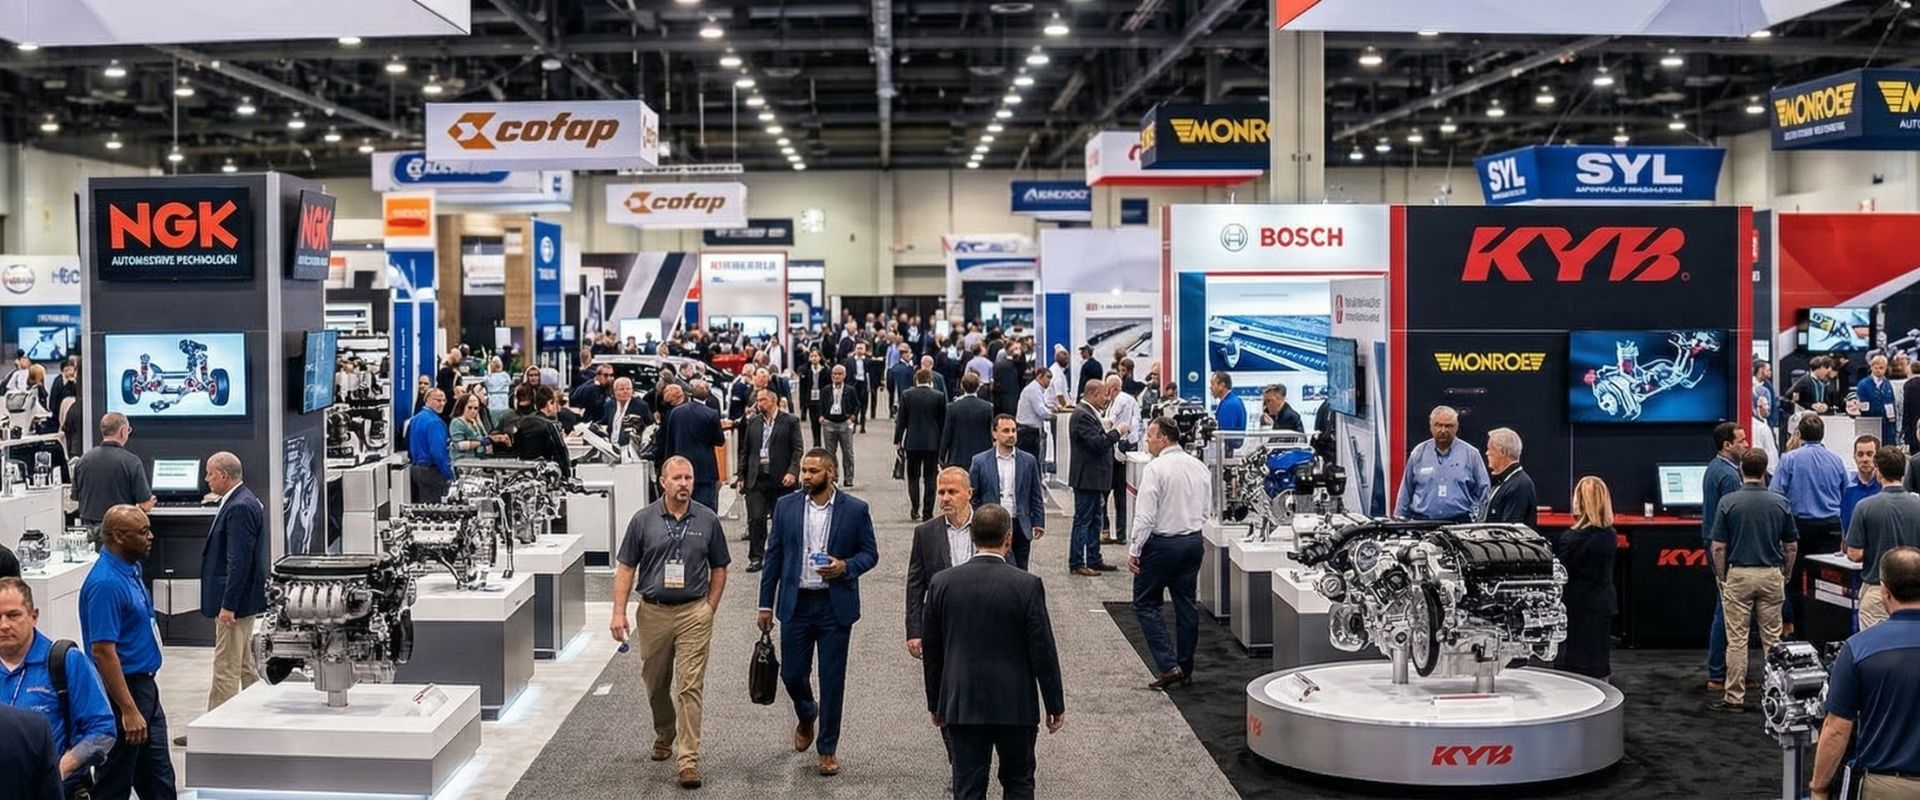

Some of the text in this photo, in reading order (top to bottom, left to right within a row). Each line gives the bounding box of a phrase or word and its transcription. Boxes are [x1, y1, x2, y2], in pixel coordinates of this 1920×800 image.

[1784, 87, 1847, 125] MONROE
[495, 111, 620, 149] cofap
[1190, 118, 1272, 144] MONR
[1487, 156, 1526, 192] SYL
[1575, 152, 1684, 185] SYL
[651, 192, 726, 214] cofap
[109, 200, 239, 249] NGK
[300, 204, 331, 250] NGK
[1260, 227, 1344, 248] BOSCH
[1460, 226, 1686, 282] KYB
[1448, 352, 1532, 371] MONROE
[1430, 744, 1515, 766] KYB
